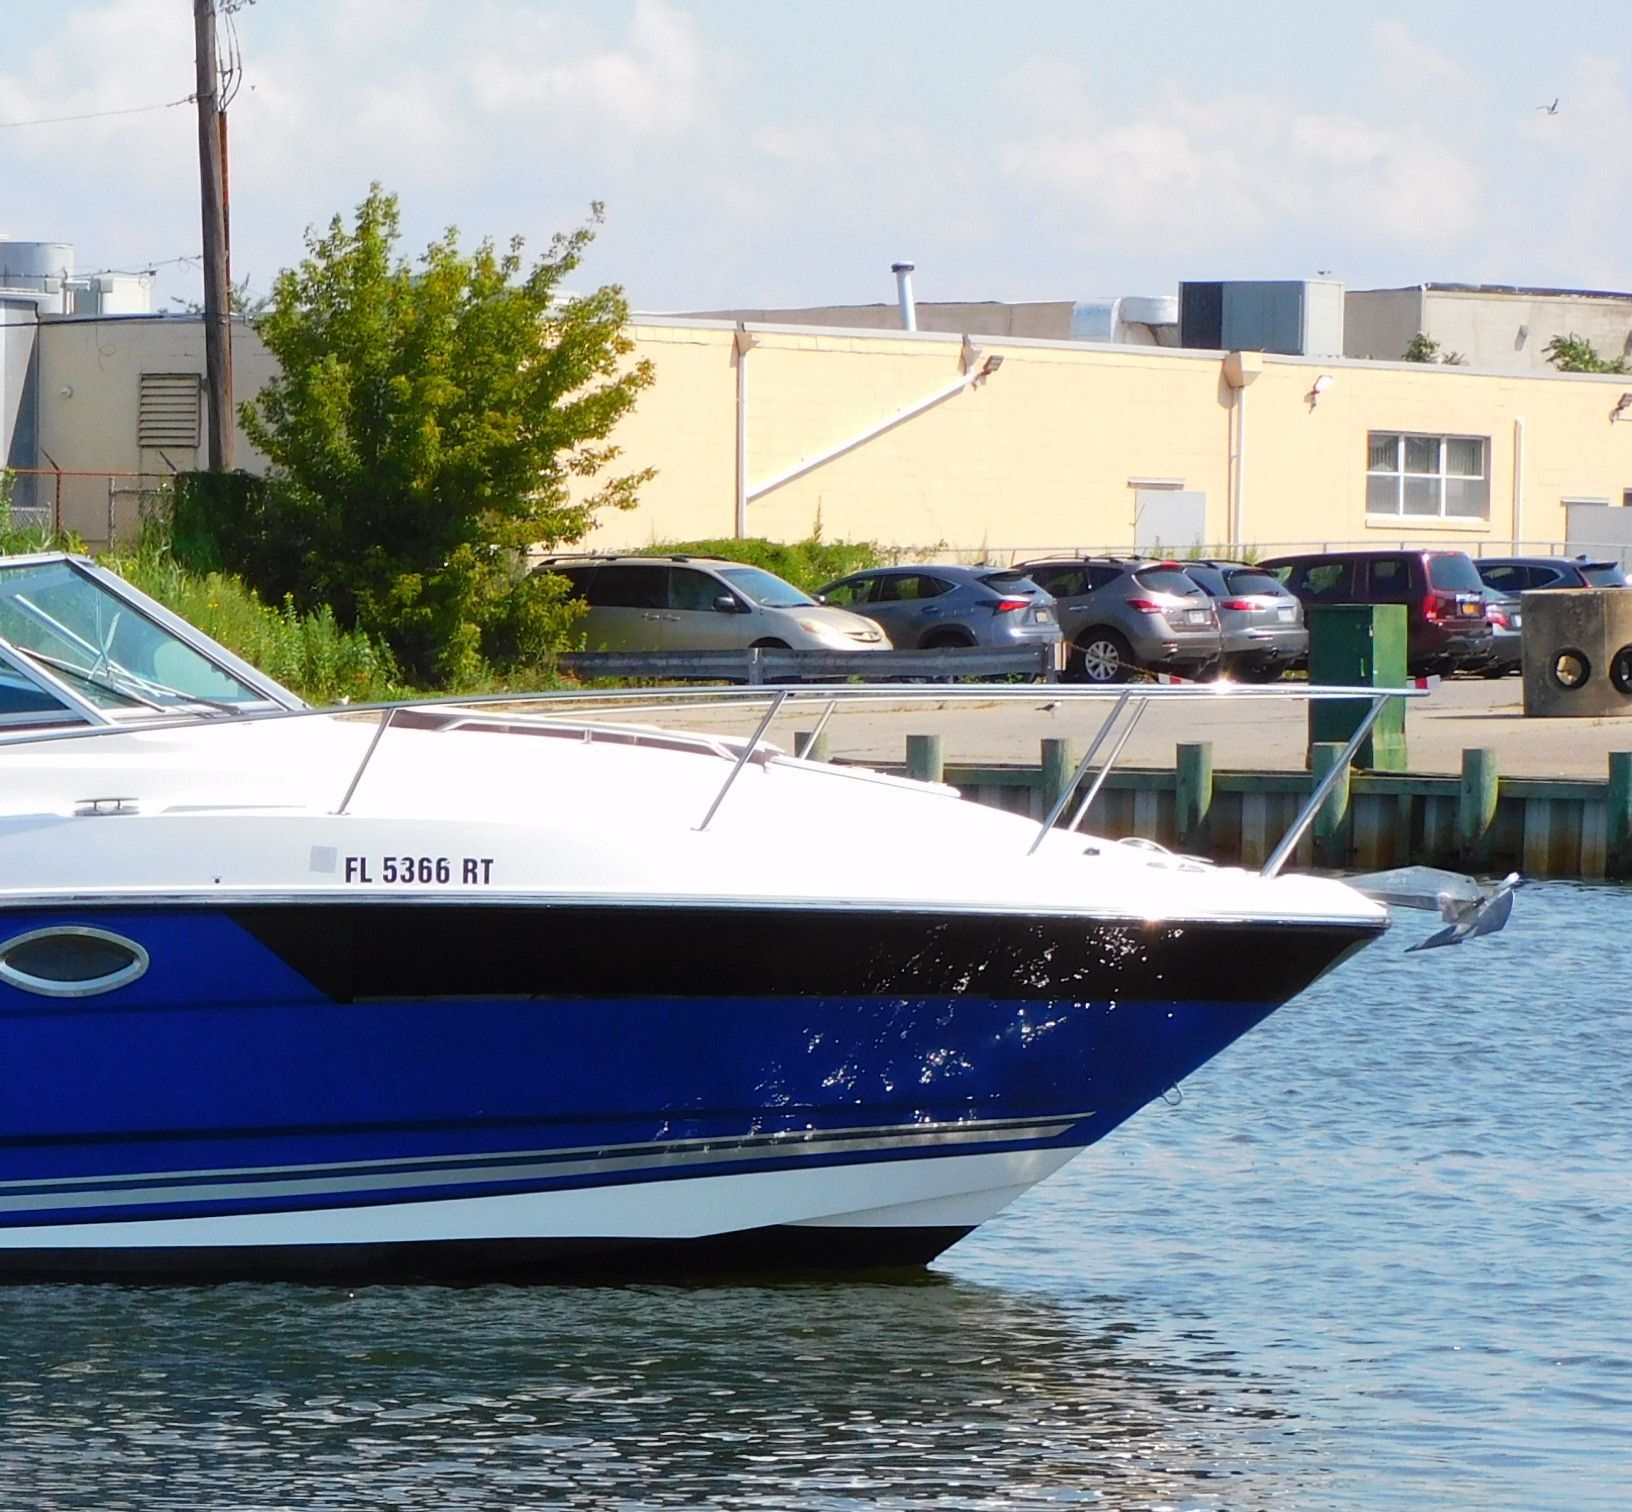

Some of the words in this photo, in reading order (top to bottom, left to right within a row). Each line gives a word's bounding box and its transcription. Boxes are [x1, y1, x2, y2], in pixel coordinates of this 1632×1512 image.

[344, 856, 373, 883] FL
[382, 856, 451, 884] 5366
[462, 858, 494, 885] RT
